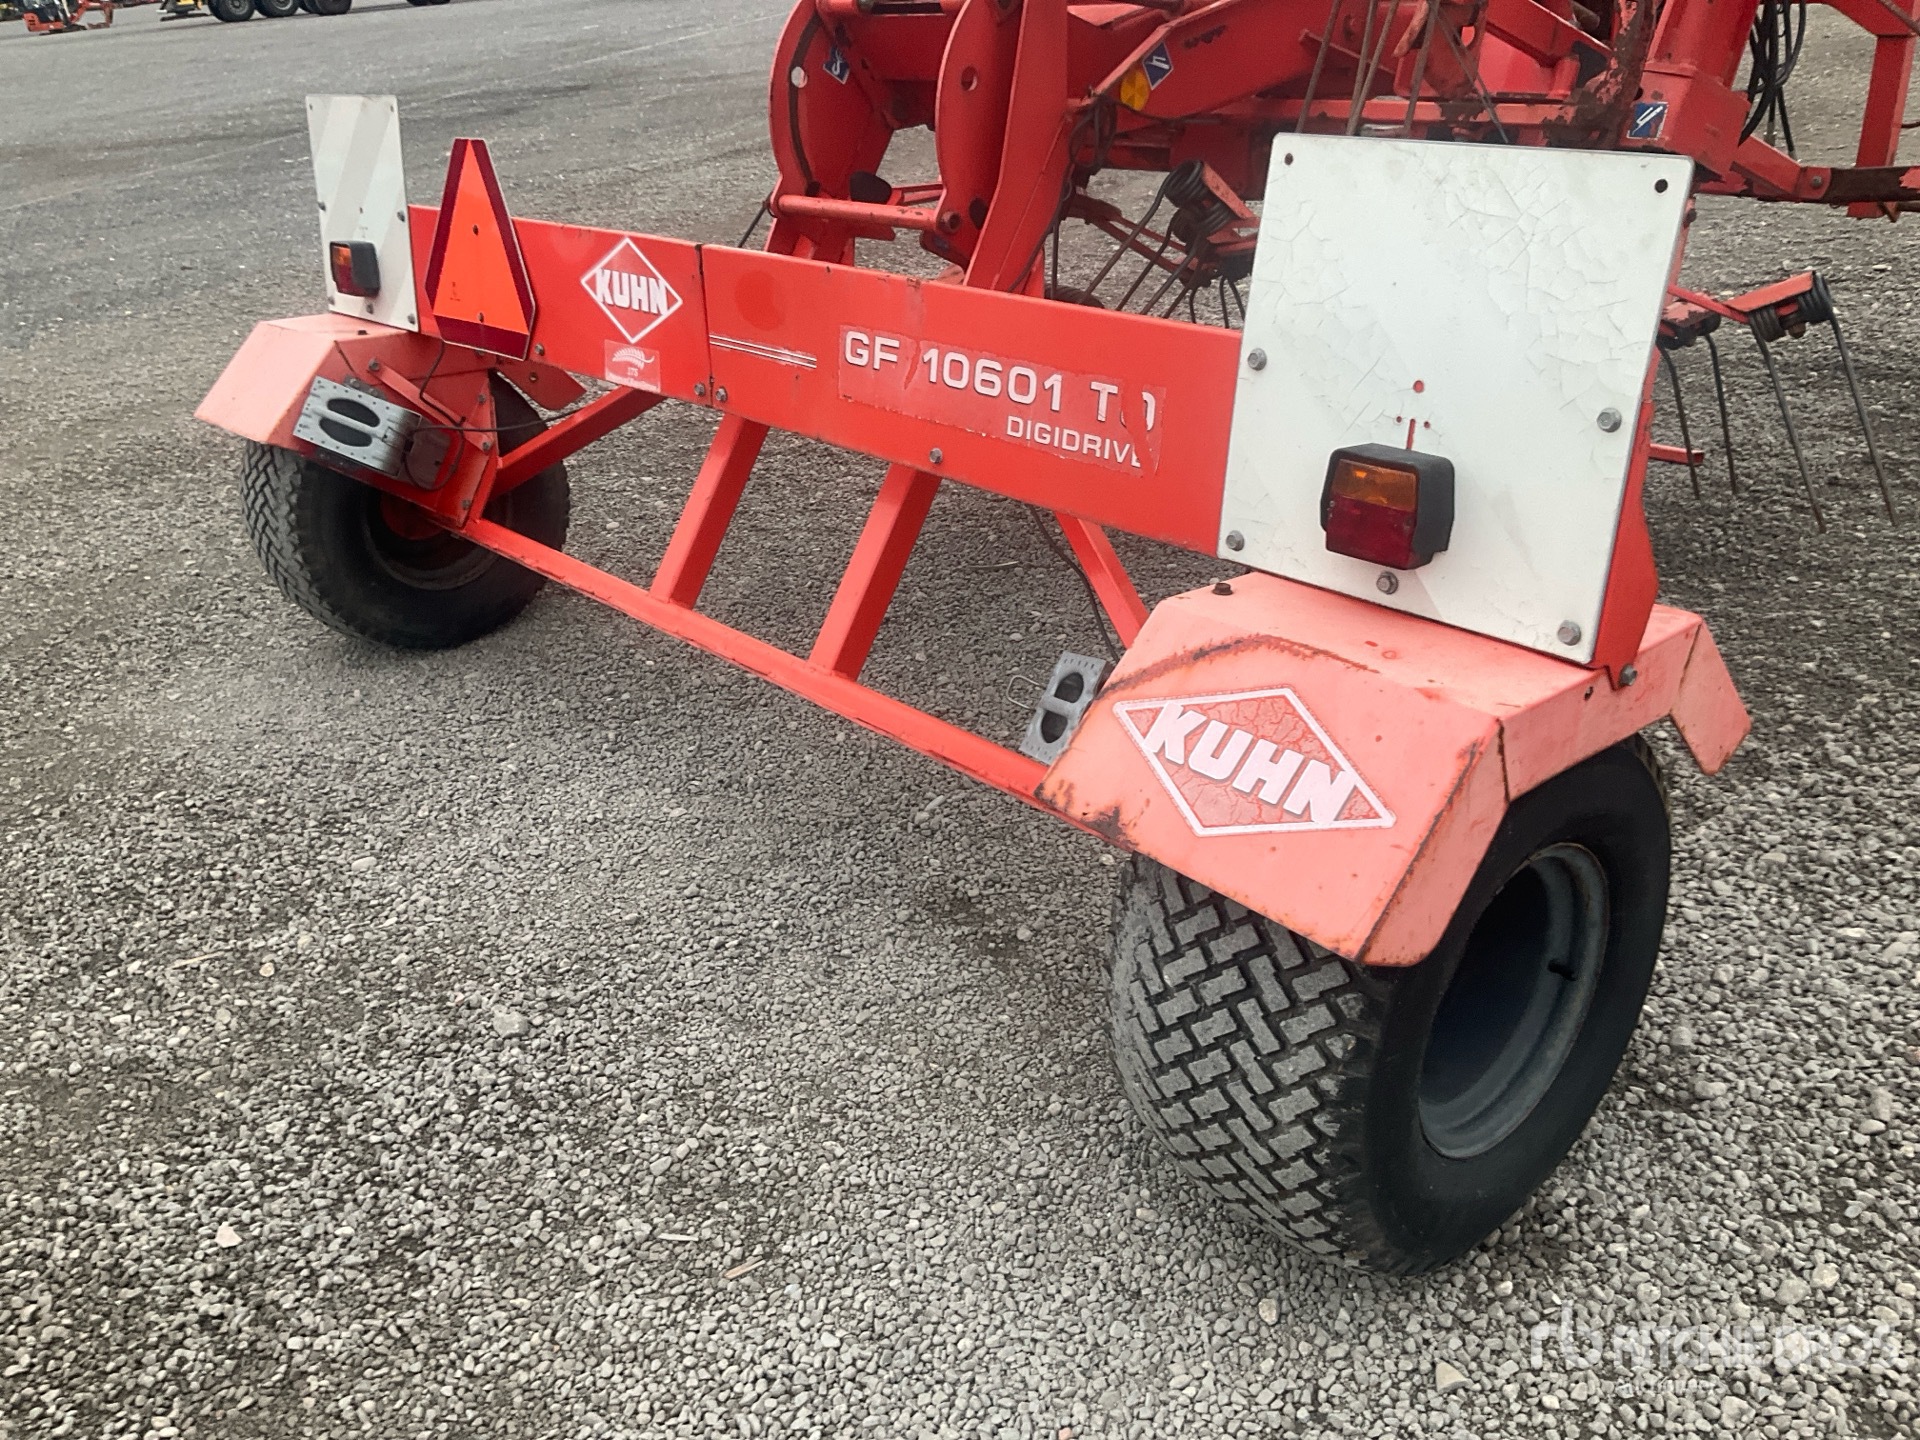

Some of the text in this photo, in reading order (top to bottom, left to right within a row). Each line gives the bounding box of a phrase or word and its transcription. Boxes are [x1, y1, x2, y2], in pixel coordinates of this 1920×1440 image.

[595, 268, 668, 315] KUHN
[844, 331, 900, 370] GF
[922, 347, 1063, 412] 10601
[1142, 702, 1356, 823] KUHN
